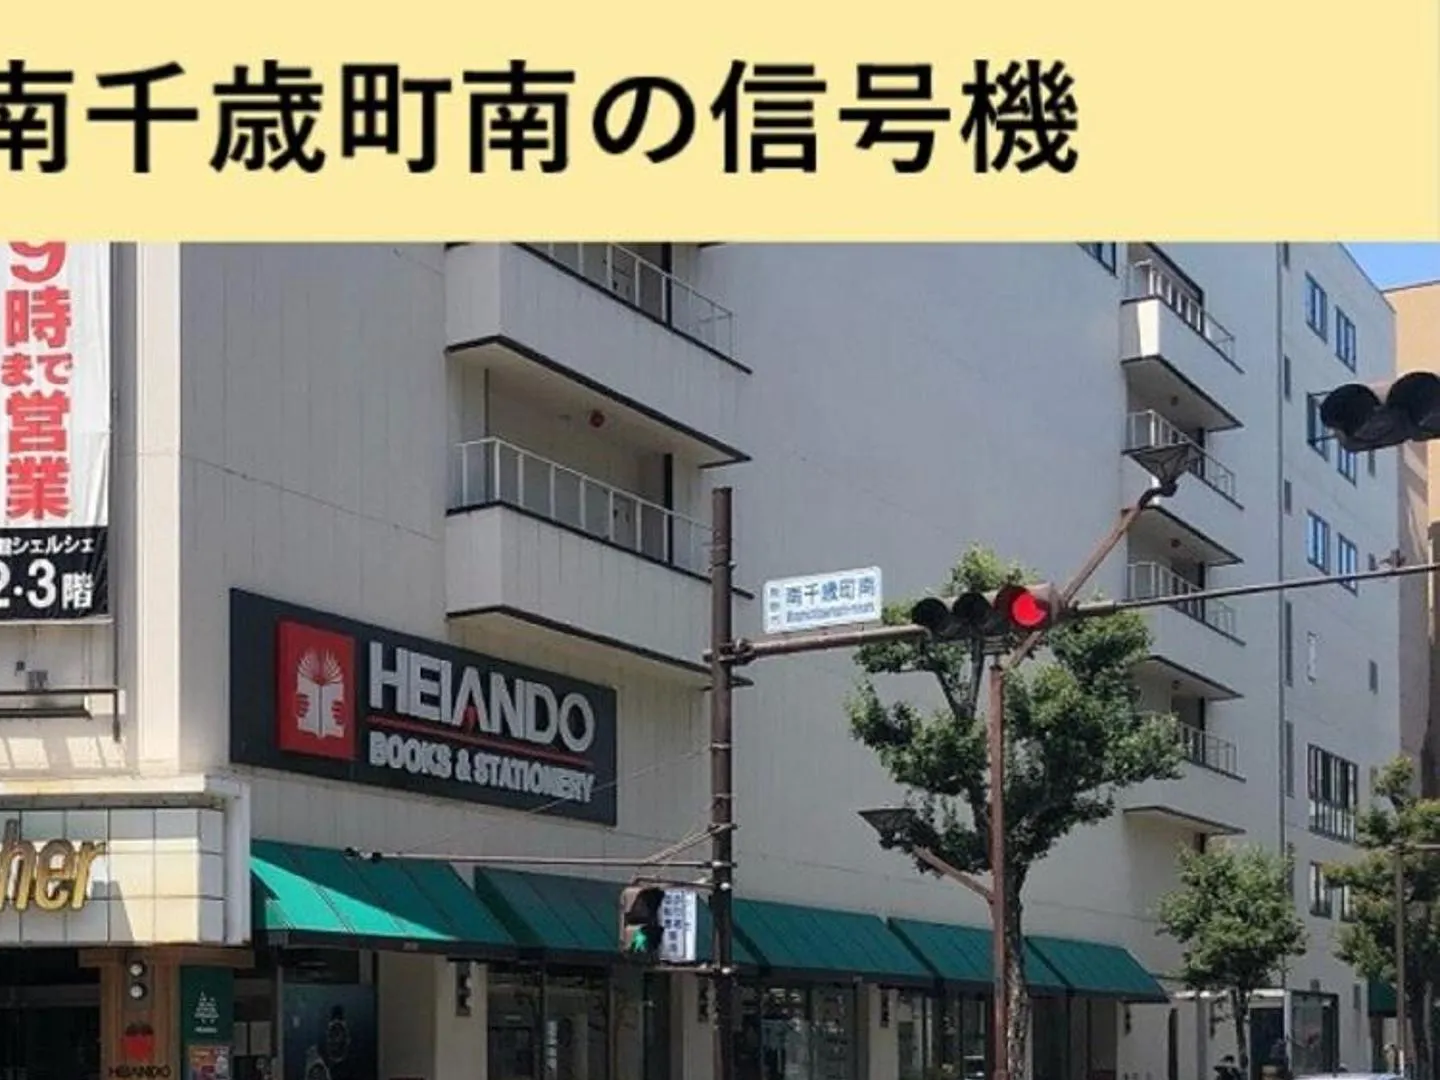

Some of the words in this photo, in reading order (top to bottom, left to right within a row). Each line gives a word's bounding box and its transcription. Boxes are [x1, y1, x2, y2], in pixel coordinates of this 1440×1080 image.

[368, 641, 596, 753] HEIANDO
[368, 731, 452, 779] BOOKS
[455, 748, 472, 783] &
[474, 751, 596, 803] STATIONERY
